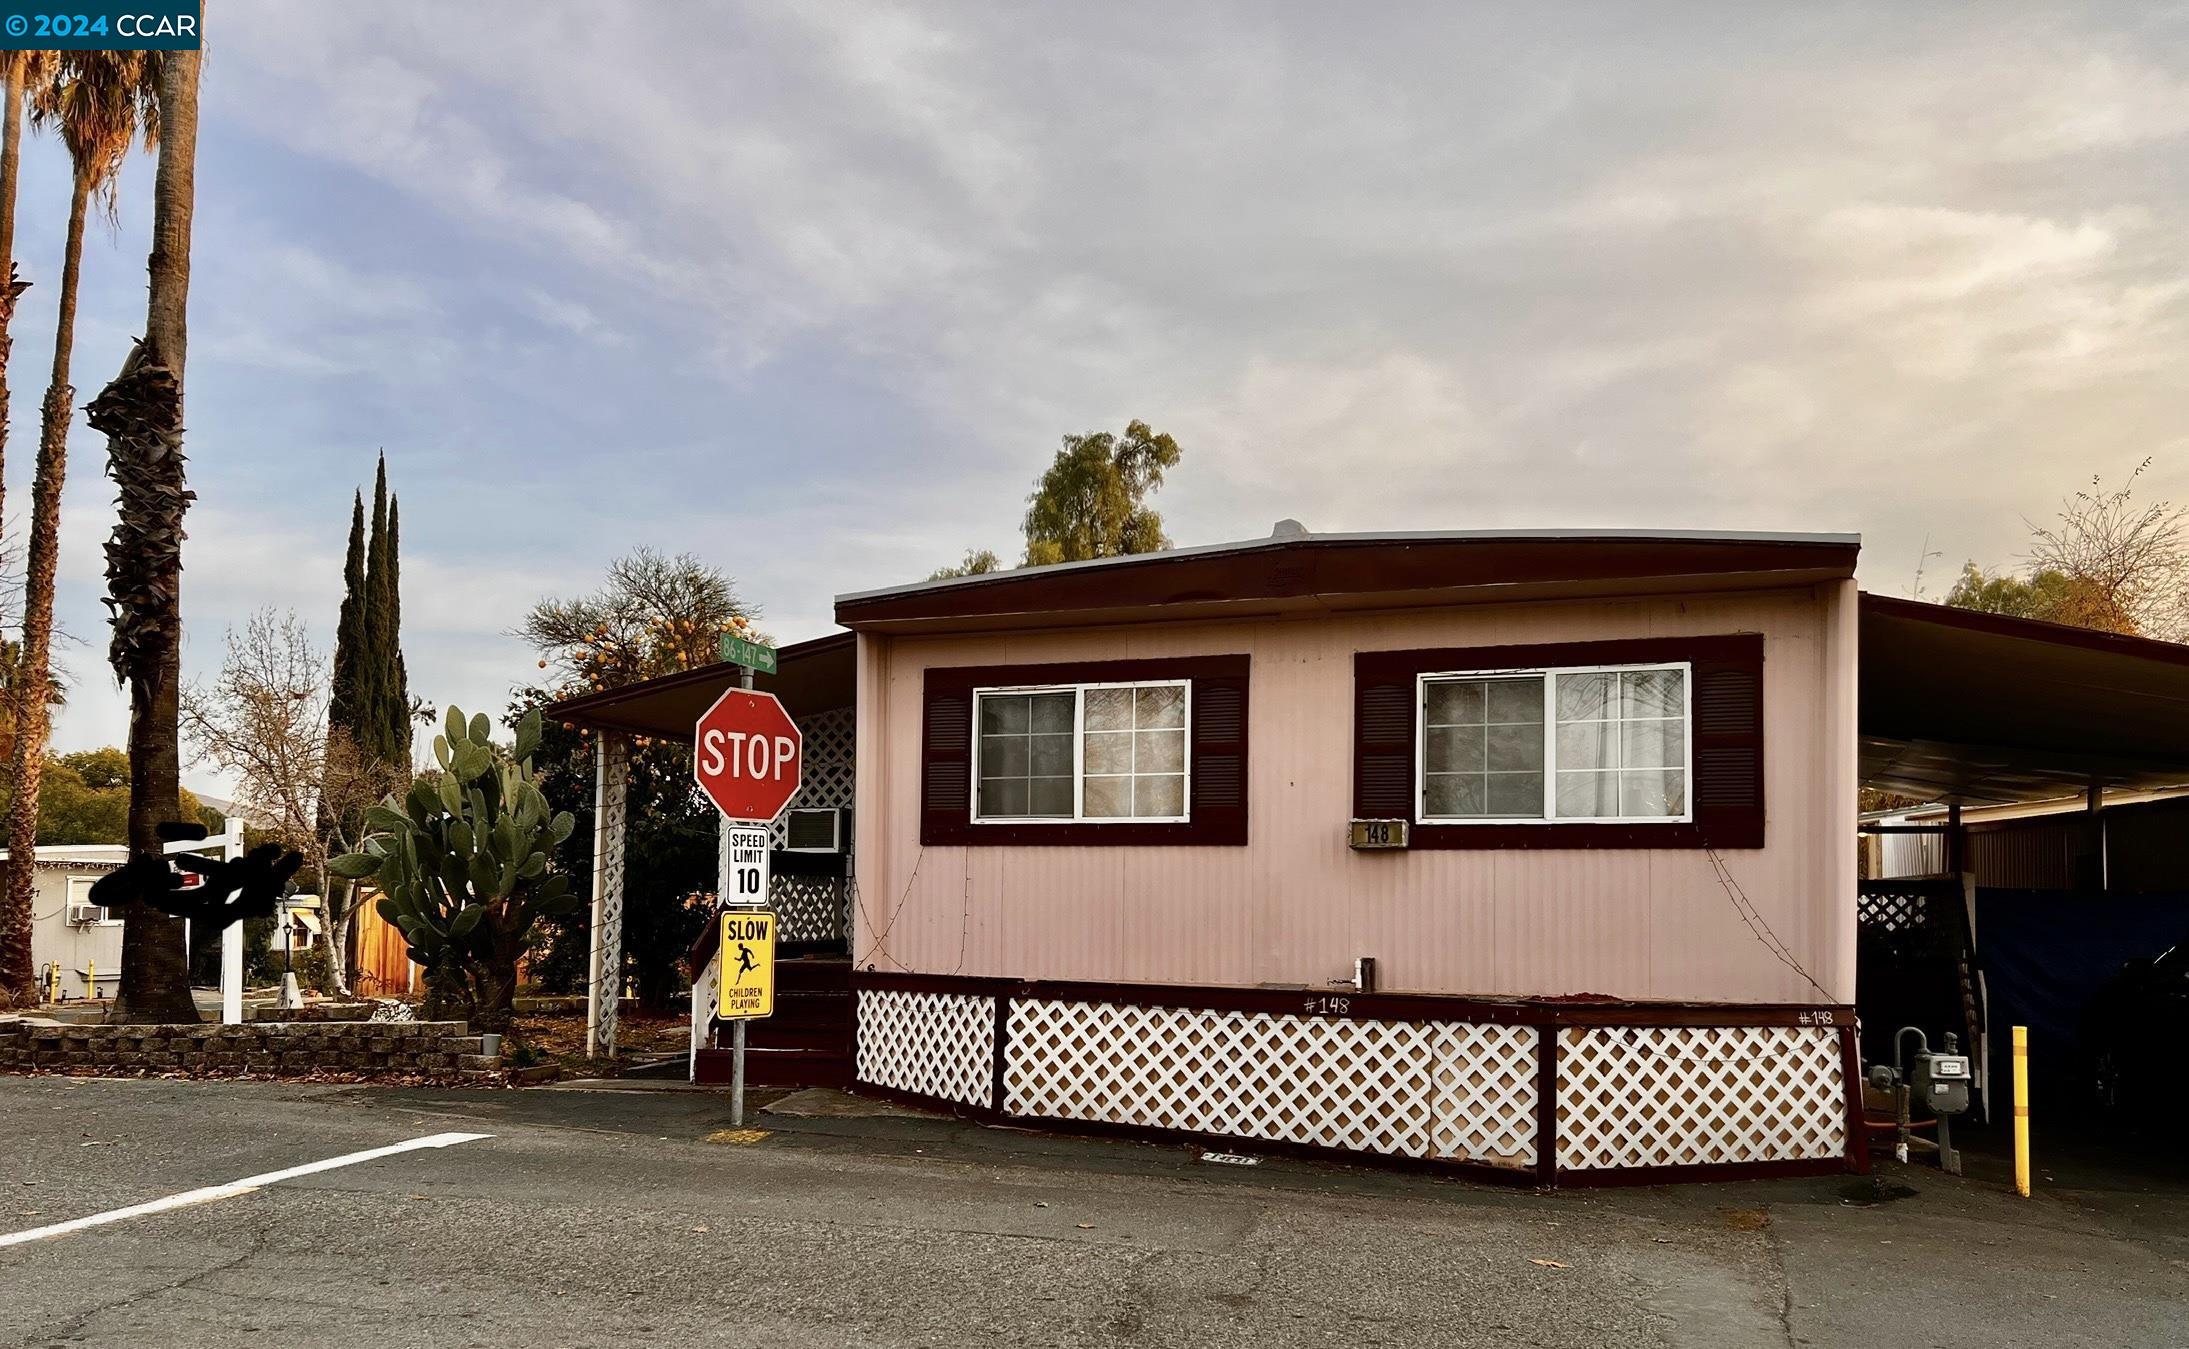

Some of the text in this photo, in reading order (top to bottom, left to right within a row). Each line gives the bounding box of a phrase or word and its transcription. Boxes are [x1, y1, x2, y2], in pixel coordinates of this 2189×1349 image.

[724, 637, 757, 665] 86-147
[702, 729, 795, 780] STOP
[732, 834, 765, 848] SPEED
[1365, 825, 1389, 843] 148
[734, 850, 763, 863] LIMIT
[737, 868, 760, 894] 10
[728, 920, 768, 941] SLOW
[729, 987, 763, 998] CHILDREN
[731, 998, 760, 1010] PLAYING
[1304, 997, 1350, 1014] #148
[1799, 1011, 1833, 1025] #148
